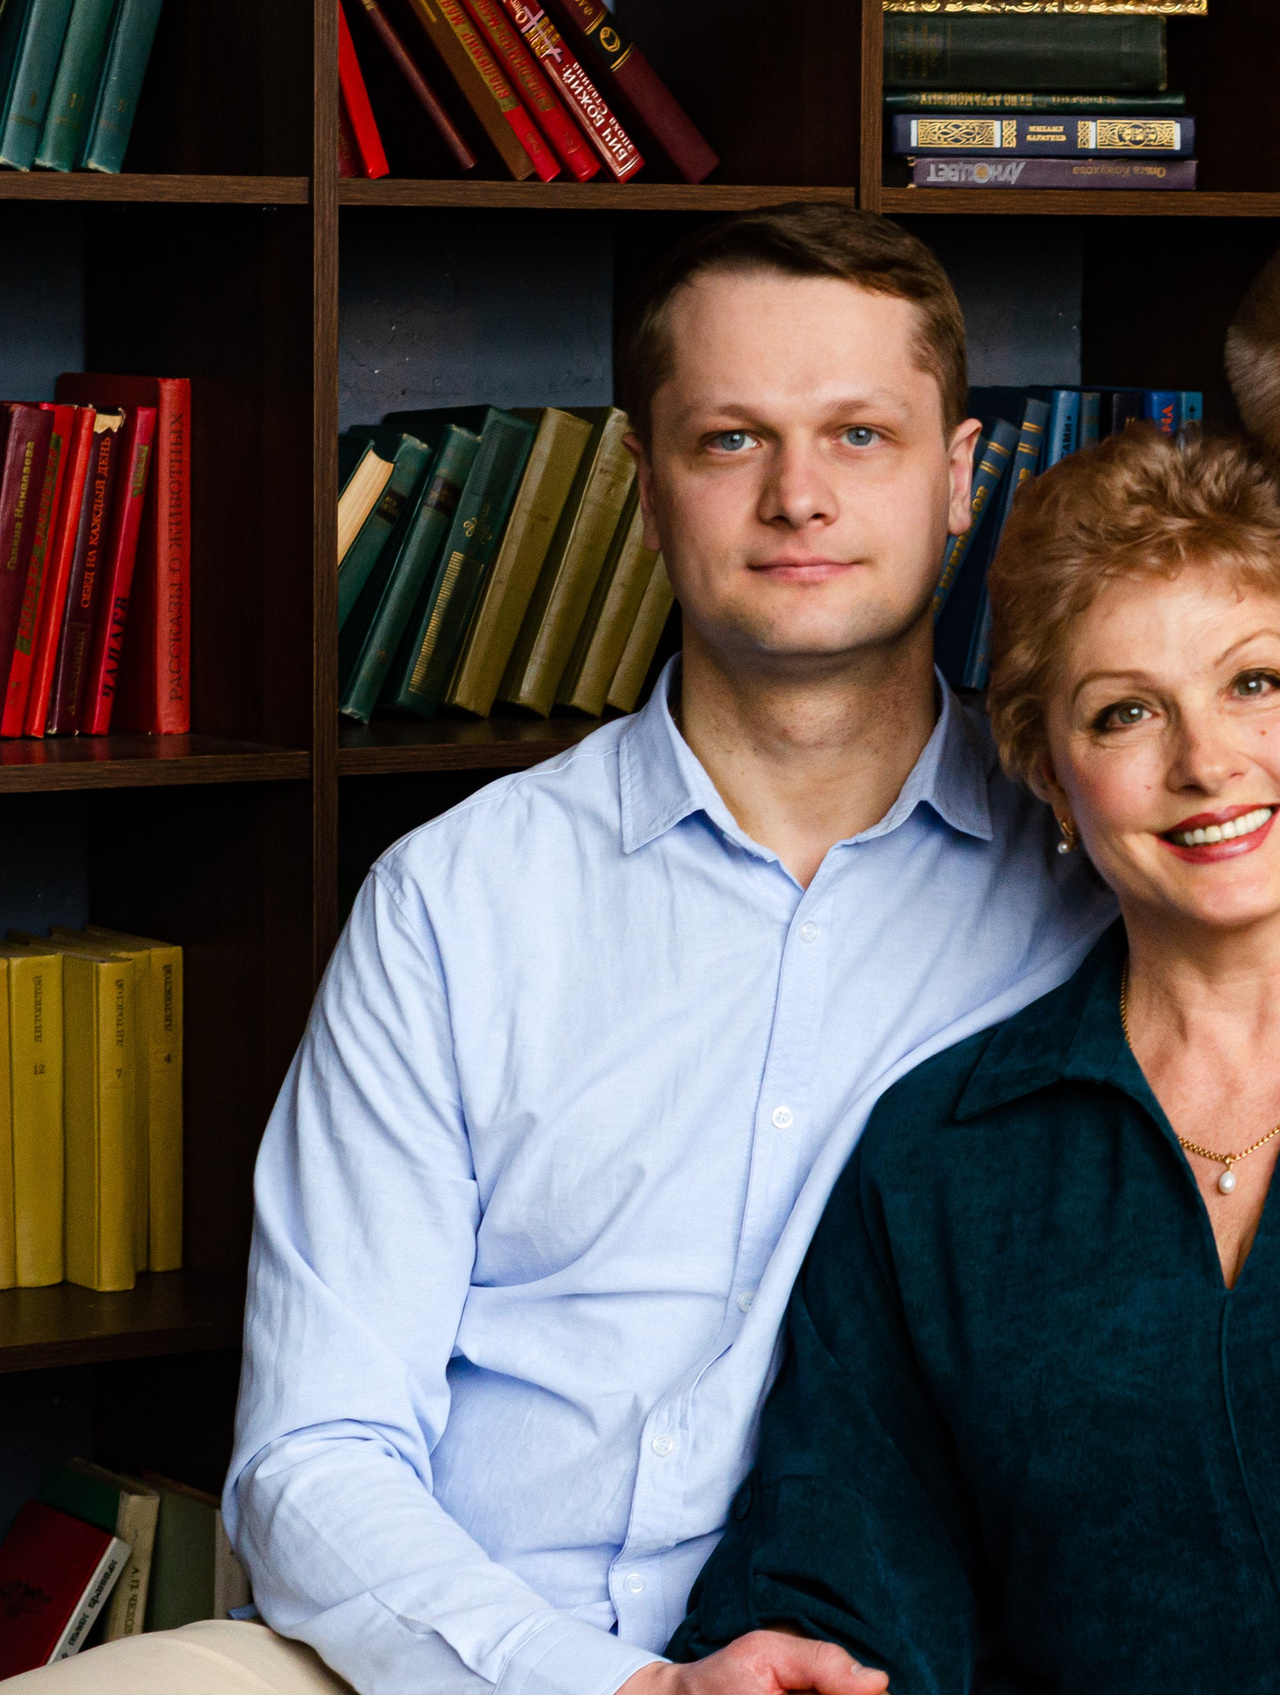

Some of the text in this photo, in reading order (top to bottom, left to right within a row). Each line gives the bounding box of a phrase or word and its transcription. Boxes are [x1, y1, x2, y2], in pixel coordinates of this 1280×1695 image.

[573, 62, 635, 152] эпоха Сталина
[602, 128, 628, 161] БИЧ
[7, 441, 35, 569] Галина Николаева
[80, 436, 110, 608] ОБЕД НА КАЖДЫЙ ДЕНЬ
[170, 557, 181, 572] О
[170, 582, 182, 701] РАССКАЗЫ
[33, 1063, 45, 1075] 12
[116, 1068, 123, 1079] 7
